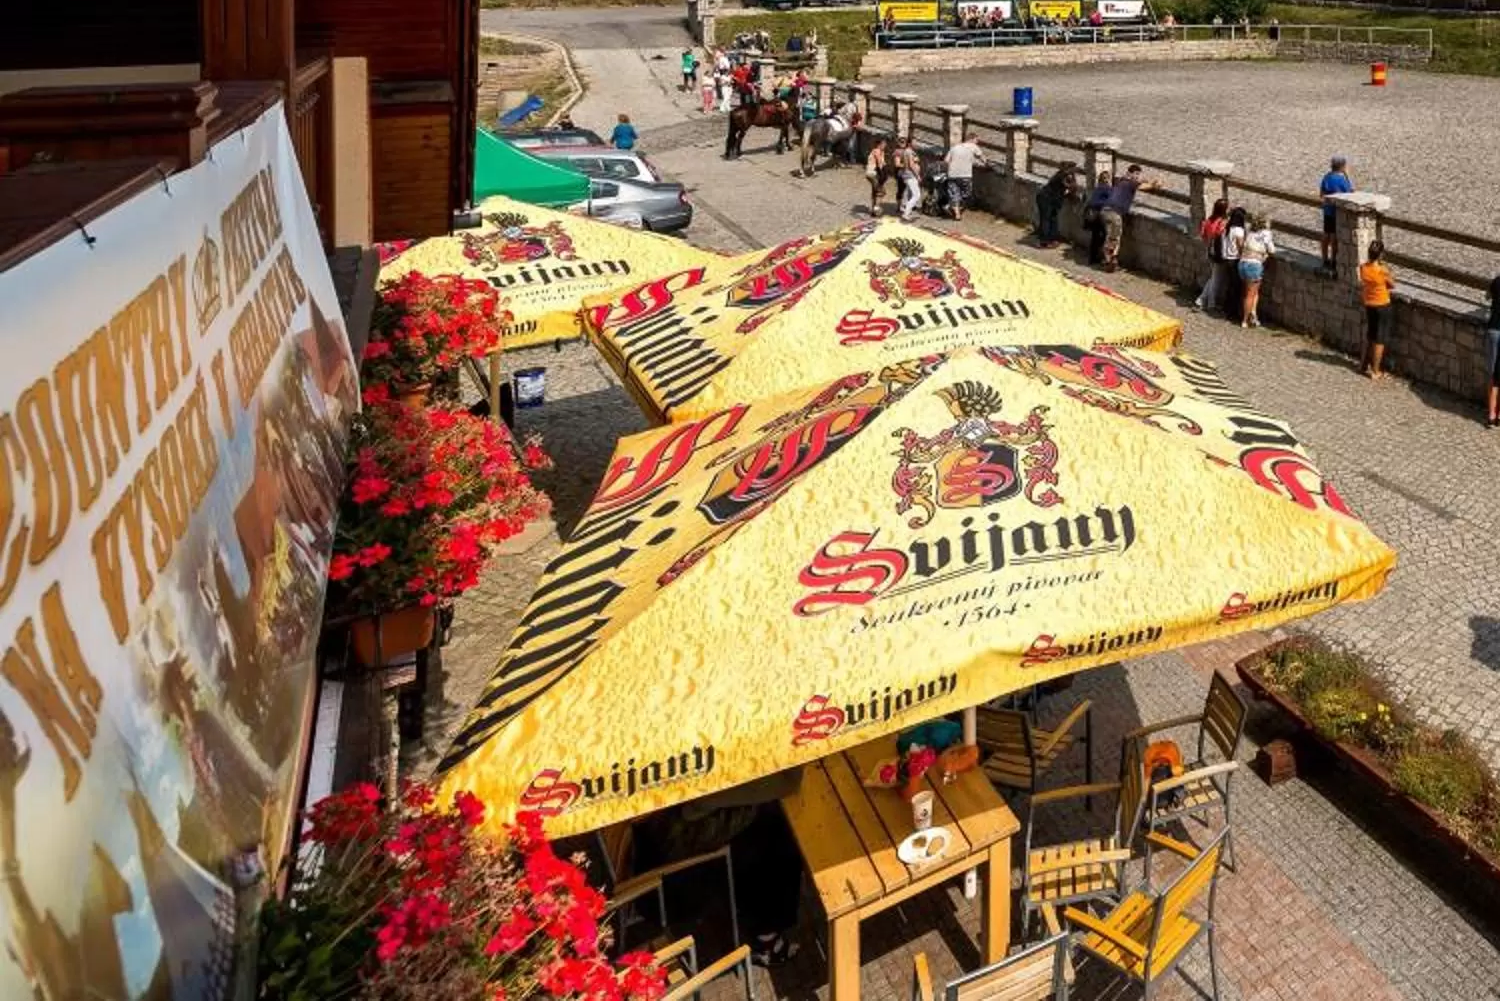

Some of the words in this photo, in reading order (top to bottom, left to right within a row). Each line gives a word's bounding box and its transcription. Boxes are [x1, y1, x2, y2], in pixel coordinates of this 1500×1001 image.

[835, 299, 1030, 346] Svijany
[0, 255, 192, 599] COUNTRY
[792, 502, 1136, 617] Svijany
[1216, 580, 1339, 625] Svijany
[1020, 625, 1163, 668] Svijany
[2, 581, 104, 803] NA
[791, 672, 958, 747] Svijany
[519, 743, 715, 817] Svijany
